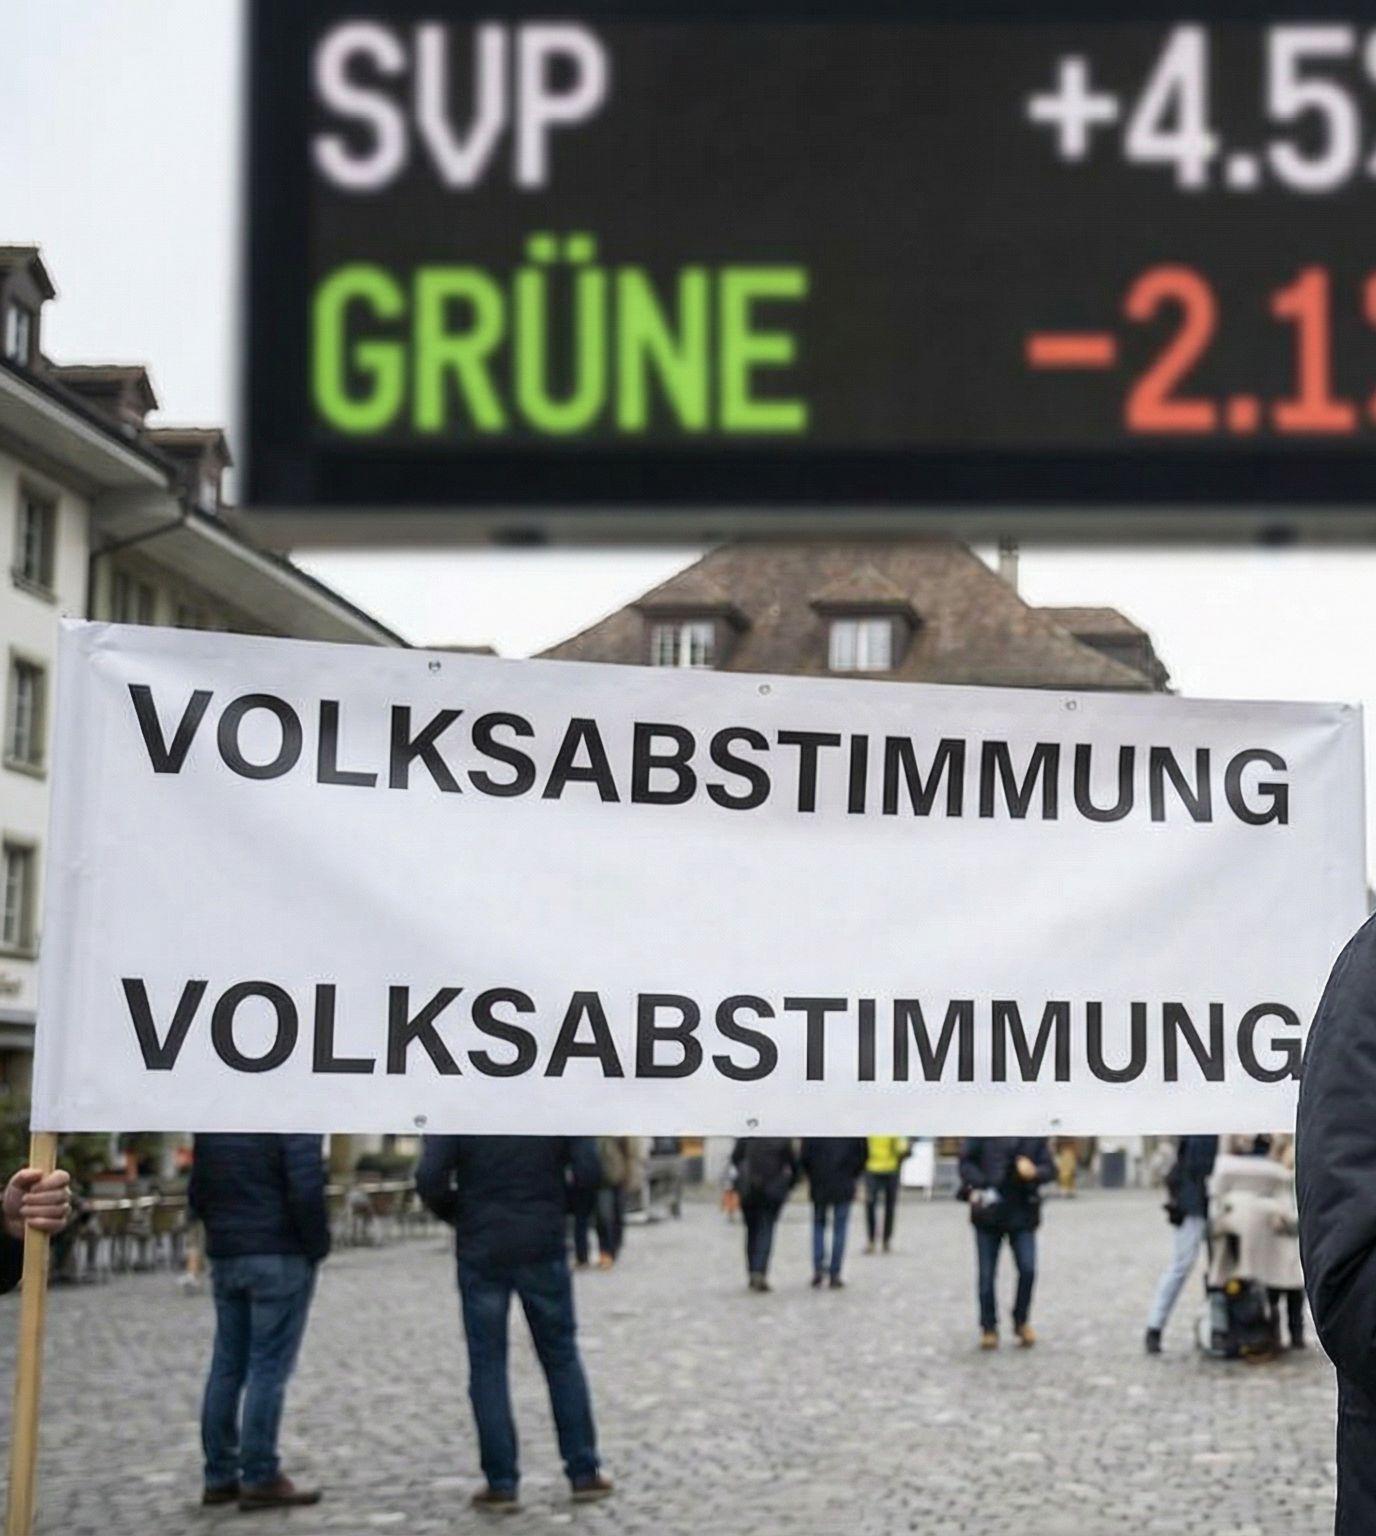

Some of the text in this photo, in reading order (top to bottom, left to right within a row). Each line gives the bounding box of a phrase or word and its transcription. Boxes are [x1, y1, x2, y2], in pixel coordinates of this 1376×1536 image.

[312, 22, 609, 191] SVP
[312, 235, 807, 434] GRÜNE
[127, 682, 1290, 827] VOLKSABSTIMMUNG
[121, 977, 1303, 1084] VOLKSABSTIMMUNG
